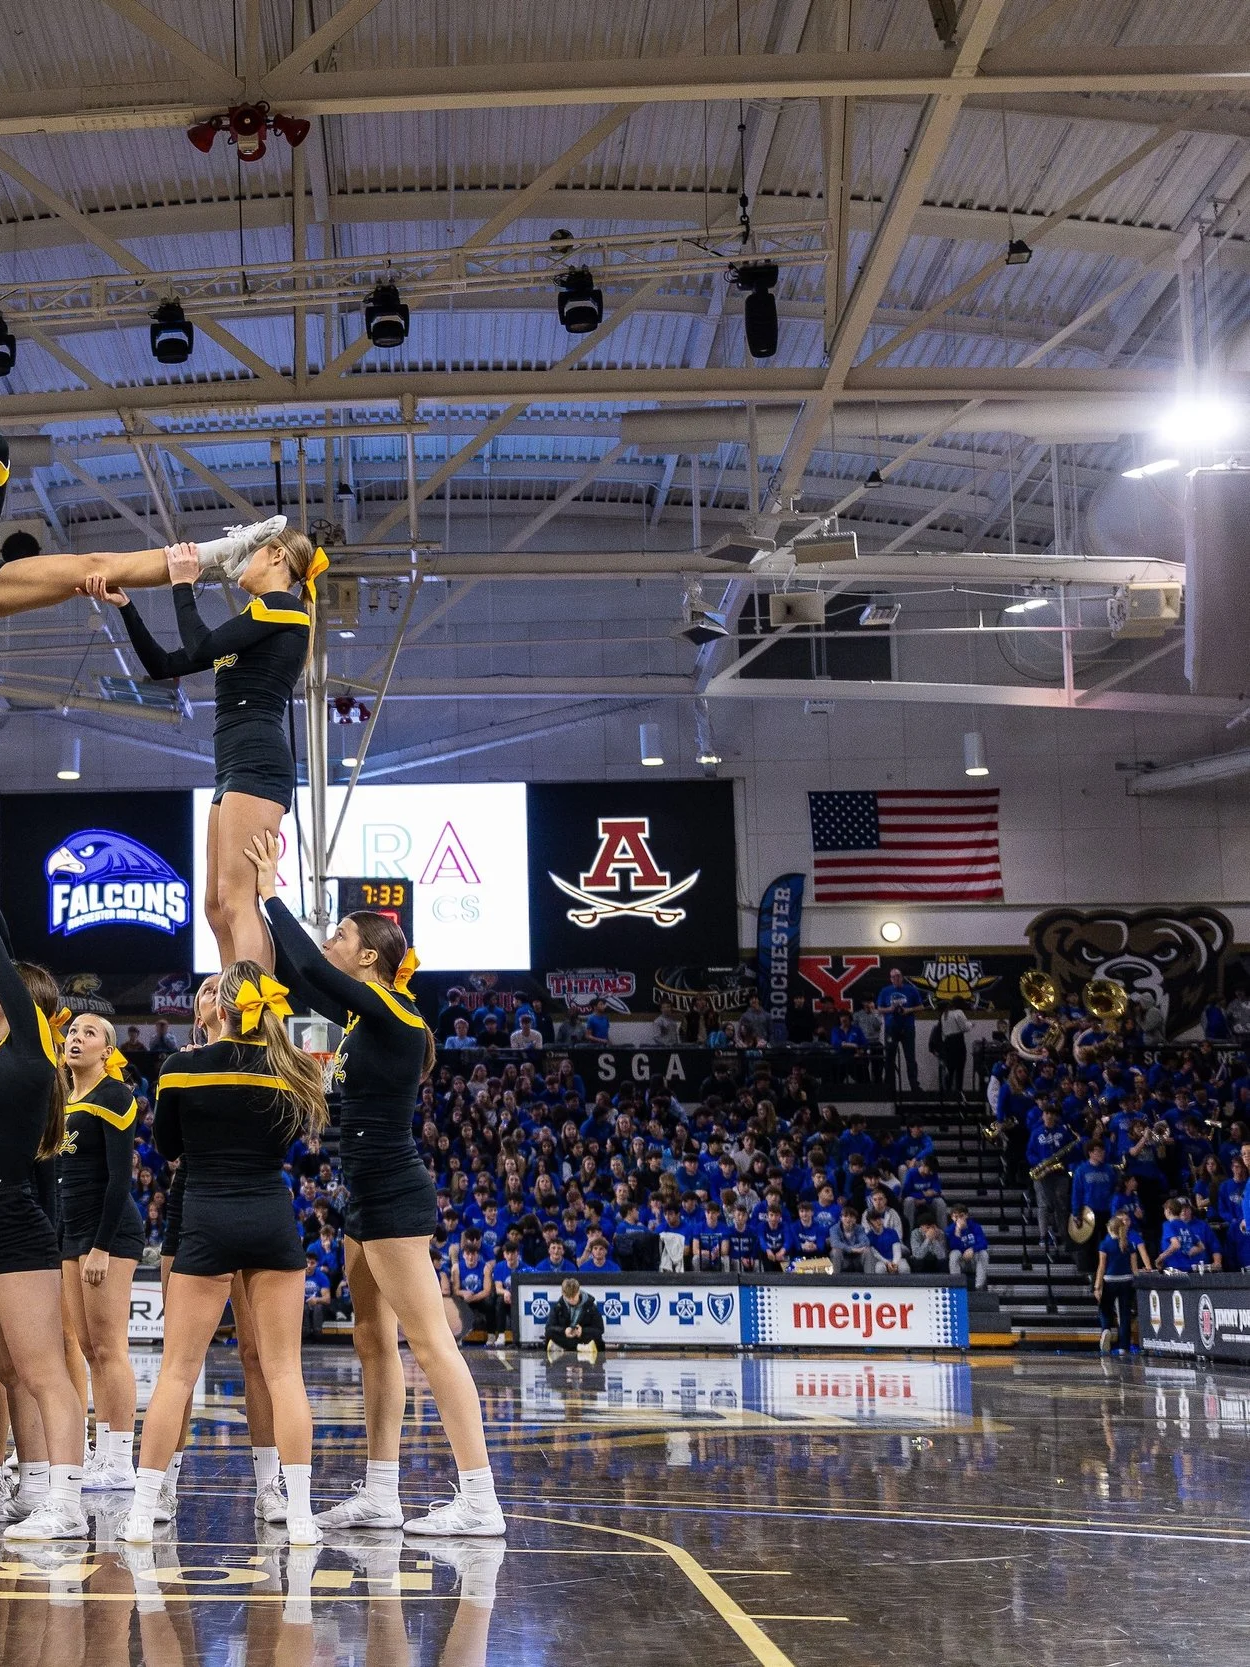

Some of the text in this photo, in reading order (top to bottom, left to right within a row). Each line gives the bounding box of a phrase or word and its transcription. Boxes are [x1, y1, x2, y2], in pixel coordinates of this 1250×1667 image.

[581, 817, 671, 891] A
[52, 882, 186, 927] FALCONS
[361, 884, 405, 906] 7:33
[770, 887, 791, 1020] ROCHESTER
[154, 995, 195, 1011] RMU
[550, 974, 633, 994] TITANS
[798, 955, 881, 1012] Y
[792, 1292, 914, 1338] meijer
